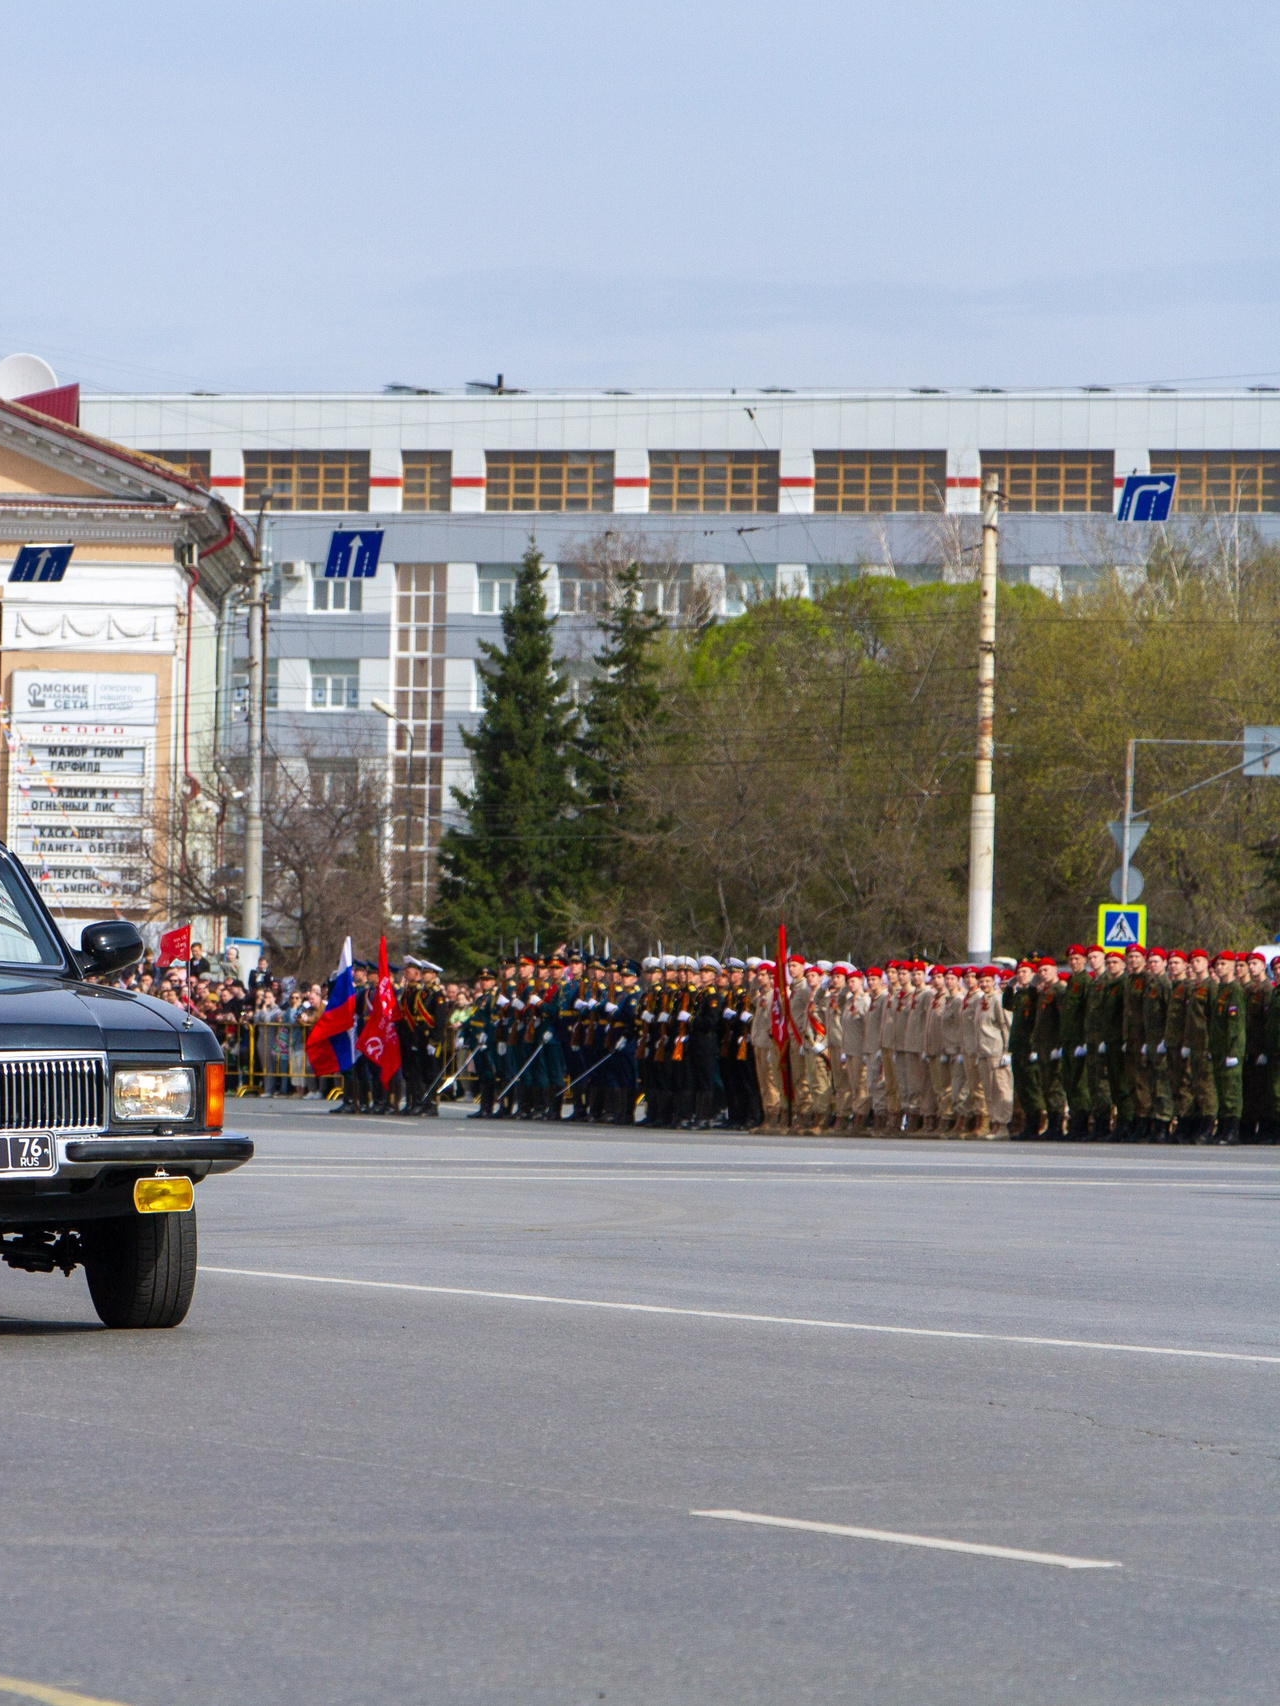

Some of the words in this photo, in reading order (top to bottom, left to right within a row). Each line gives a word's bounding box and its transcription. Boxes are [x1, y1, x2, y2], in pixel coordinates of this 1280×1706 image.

[100, 684, 142, 693] оператор
[54, 700, 89, 709] СЕТИ
[42, 725, 124, 734] СКОРО
[94, 747, 124, 758] ГРОМ
[50, 760, 101, 773] ГАРФИЛД
[95, 802, 115, 812] ЛИС
[18, 1138, 42, 1157] 76
[20, 1156, 40, 1167] RUS
